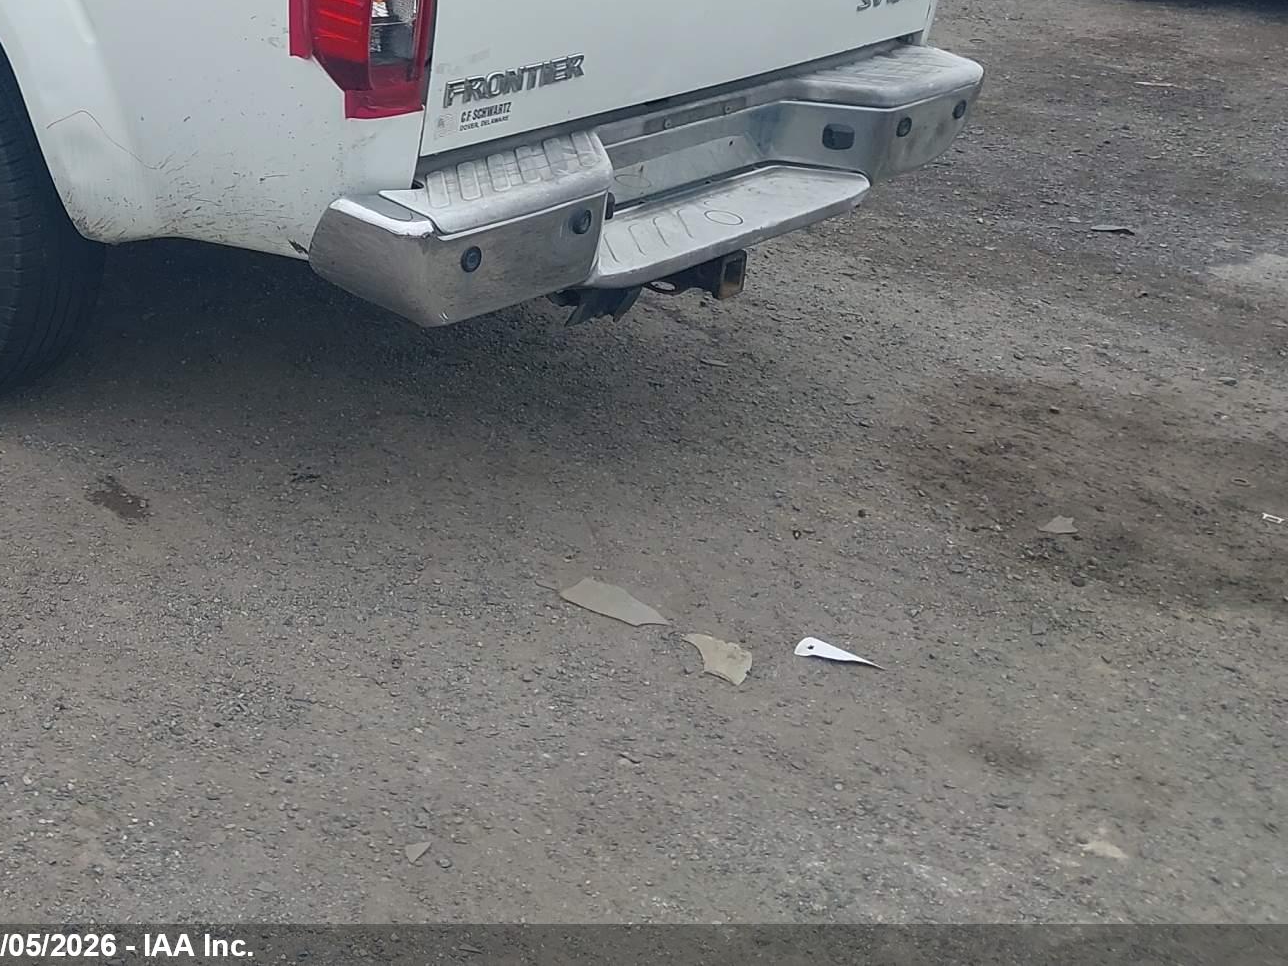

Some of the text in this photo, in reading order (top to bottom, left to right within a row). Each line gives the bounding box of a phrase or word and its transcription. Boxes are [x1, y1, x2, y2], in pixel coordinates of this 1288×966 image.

[443, 52, 585, 108] FRONTIER
[472, 102, 512, 120] SCHWARTZ
[480, 115, 509, 127] DELAWARE
